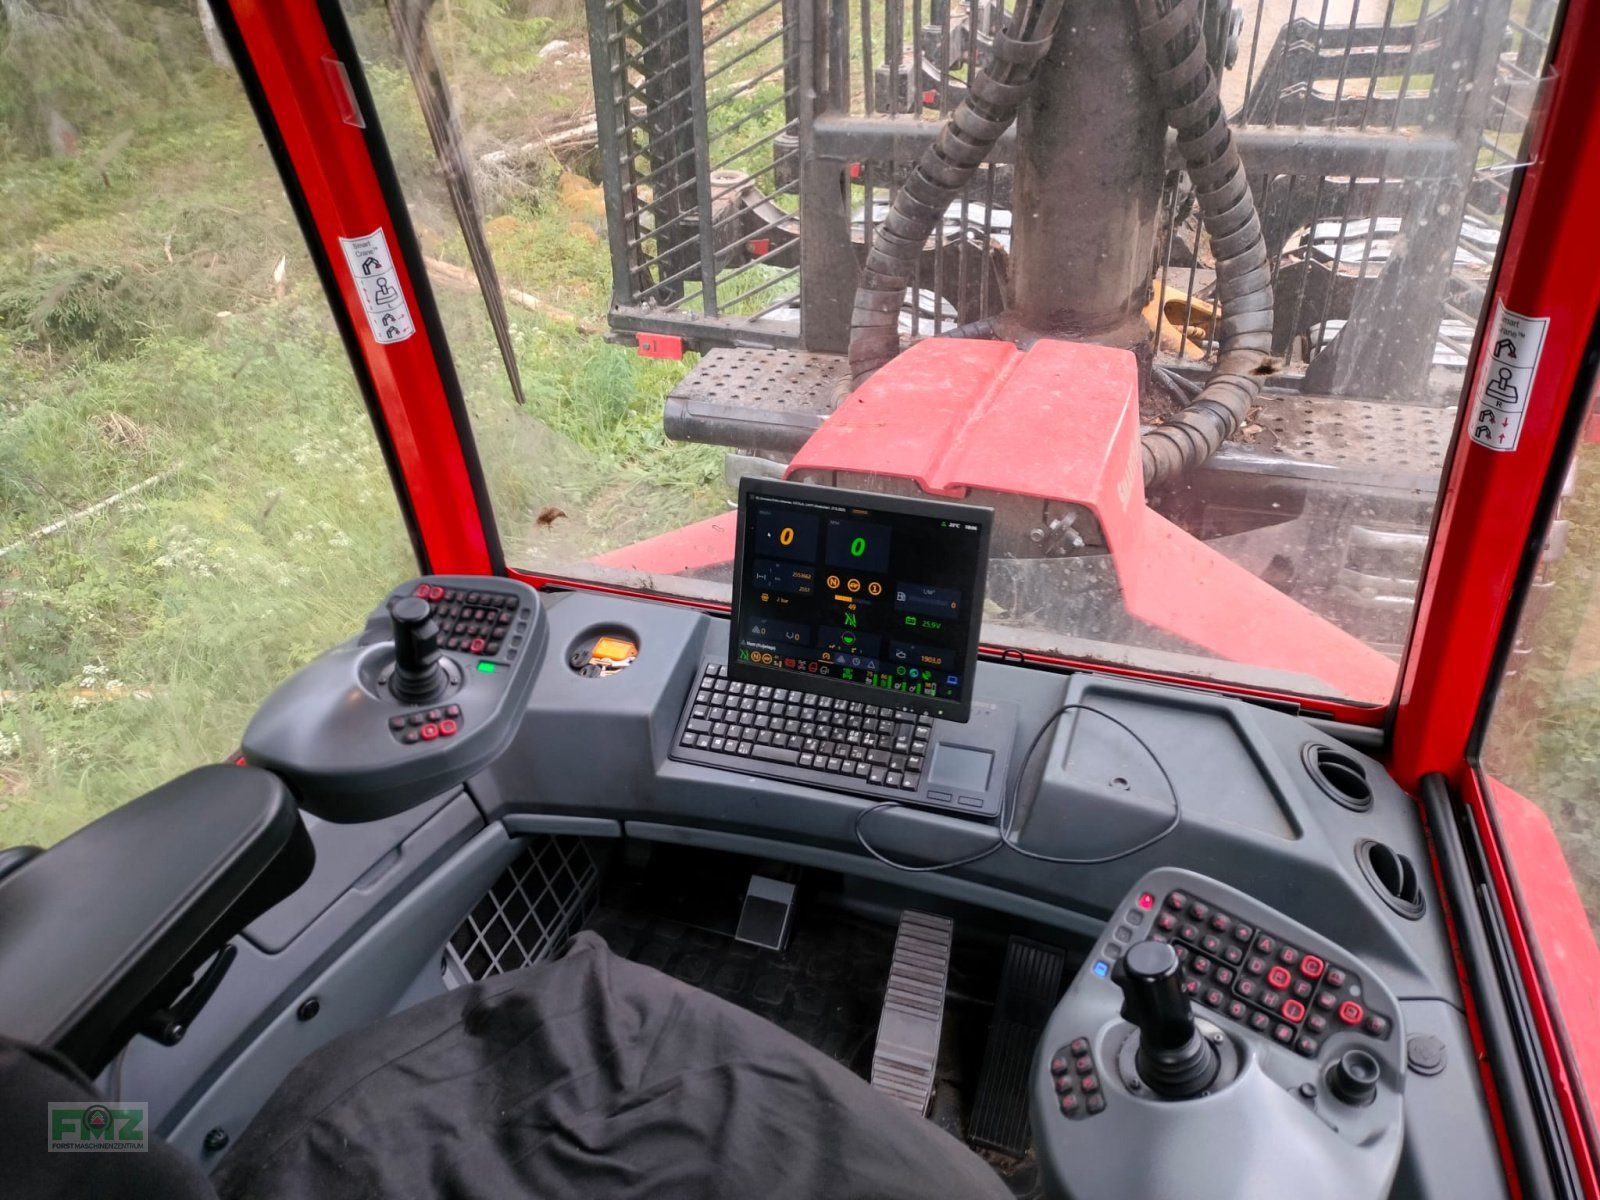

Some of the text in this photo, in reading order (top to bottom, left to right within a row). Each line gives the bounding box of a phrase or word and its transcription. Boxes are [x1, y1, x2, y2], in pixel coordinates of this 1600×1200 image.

[352, 240, 371, 250] Smart
[780, 527, 795, 546] 0
[850, 537, 867, 557] 0
